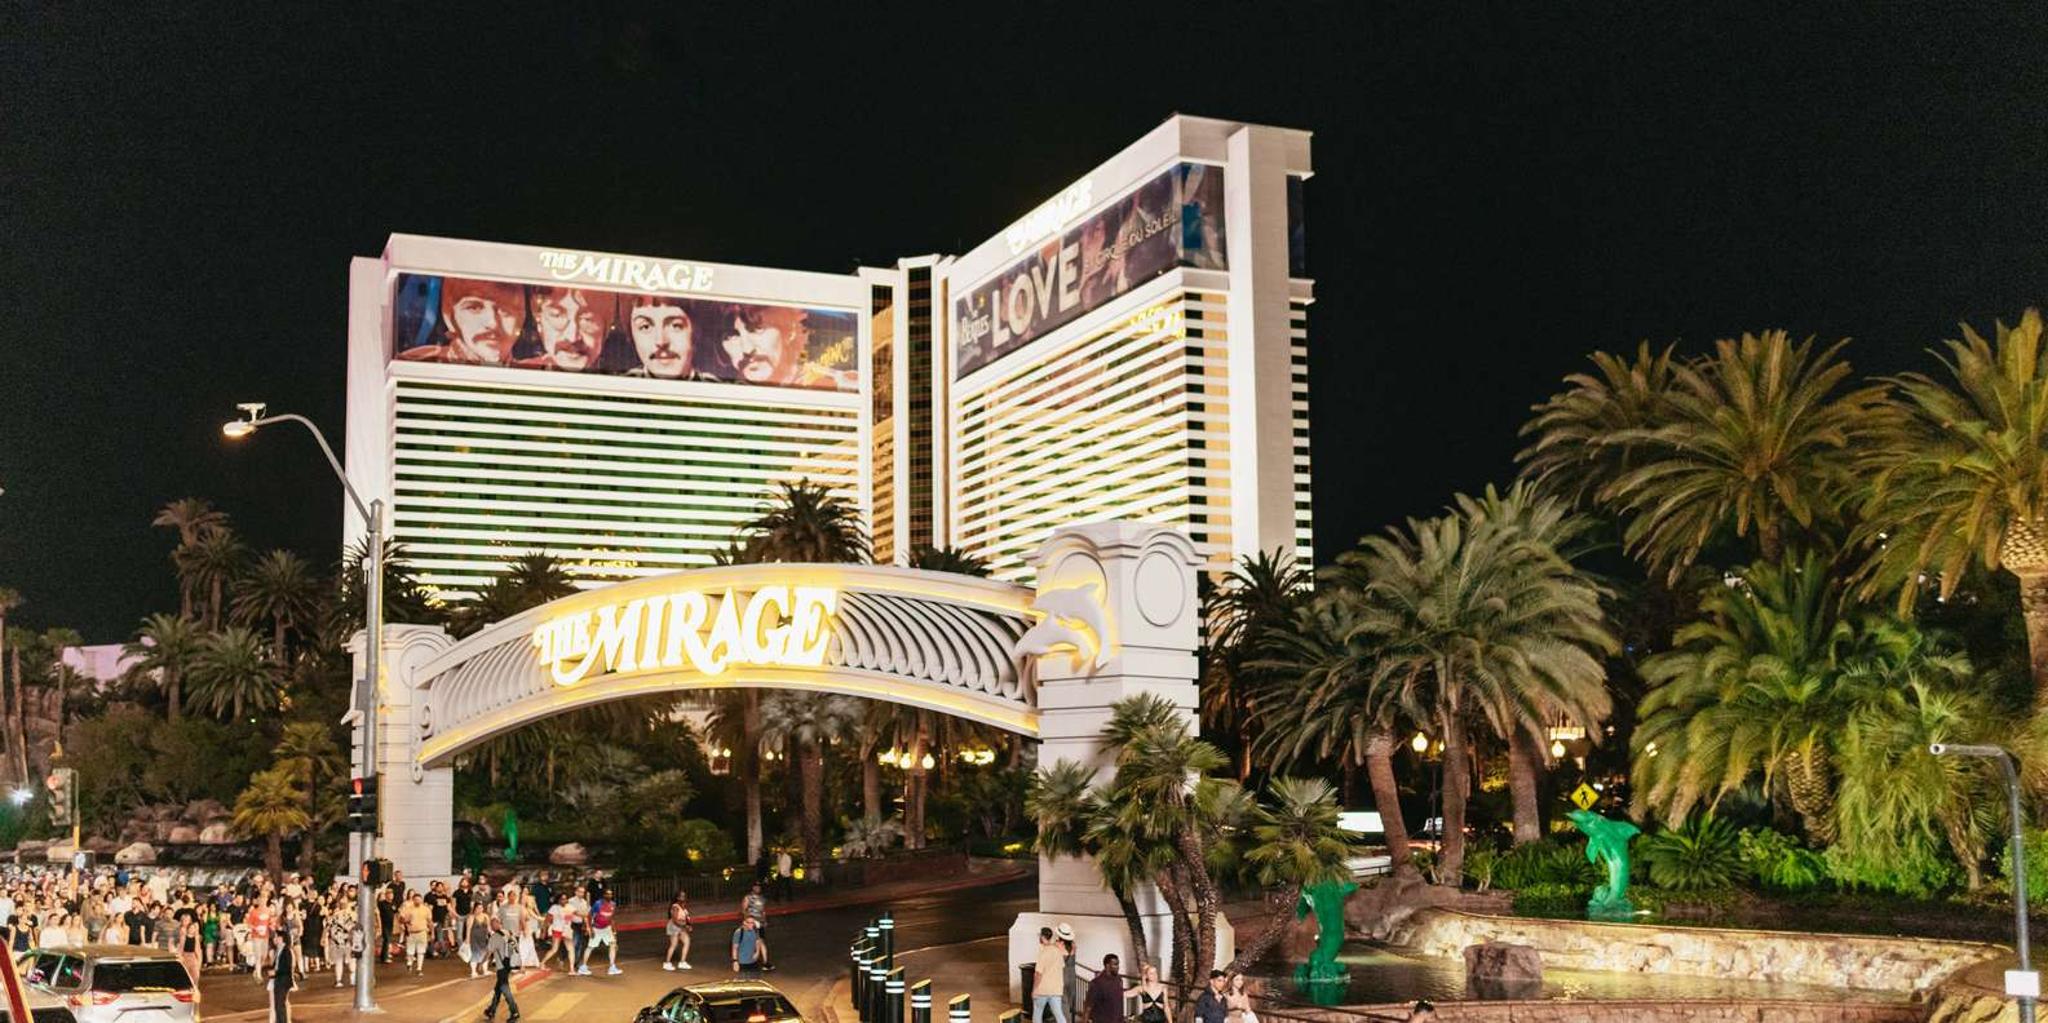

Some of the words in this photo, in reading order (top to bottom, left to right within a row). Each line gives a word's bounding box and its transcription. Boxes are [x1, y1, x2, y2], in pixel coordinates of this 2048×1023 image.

[539, 251, 578, 273] THE
[552, 256, 714, 291] MIRAGE
[992, 242, 1080, 348] LOVE
[533, 610, 591, 666] THE
[552, 586, 837, 685] MIRAGE
